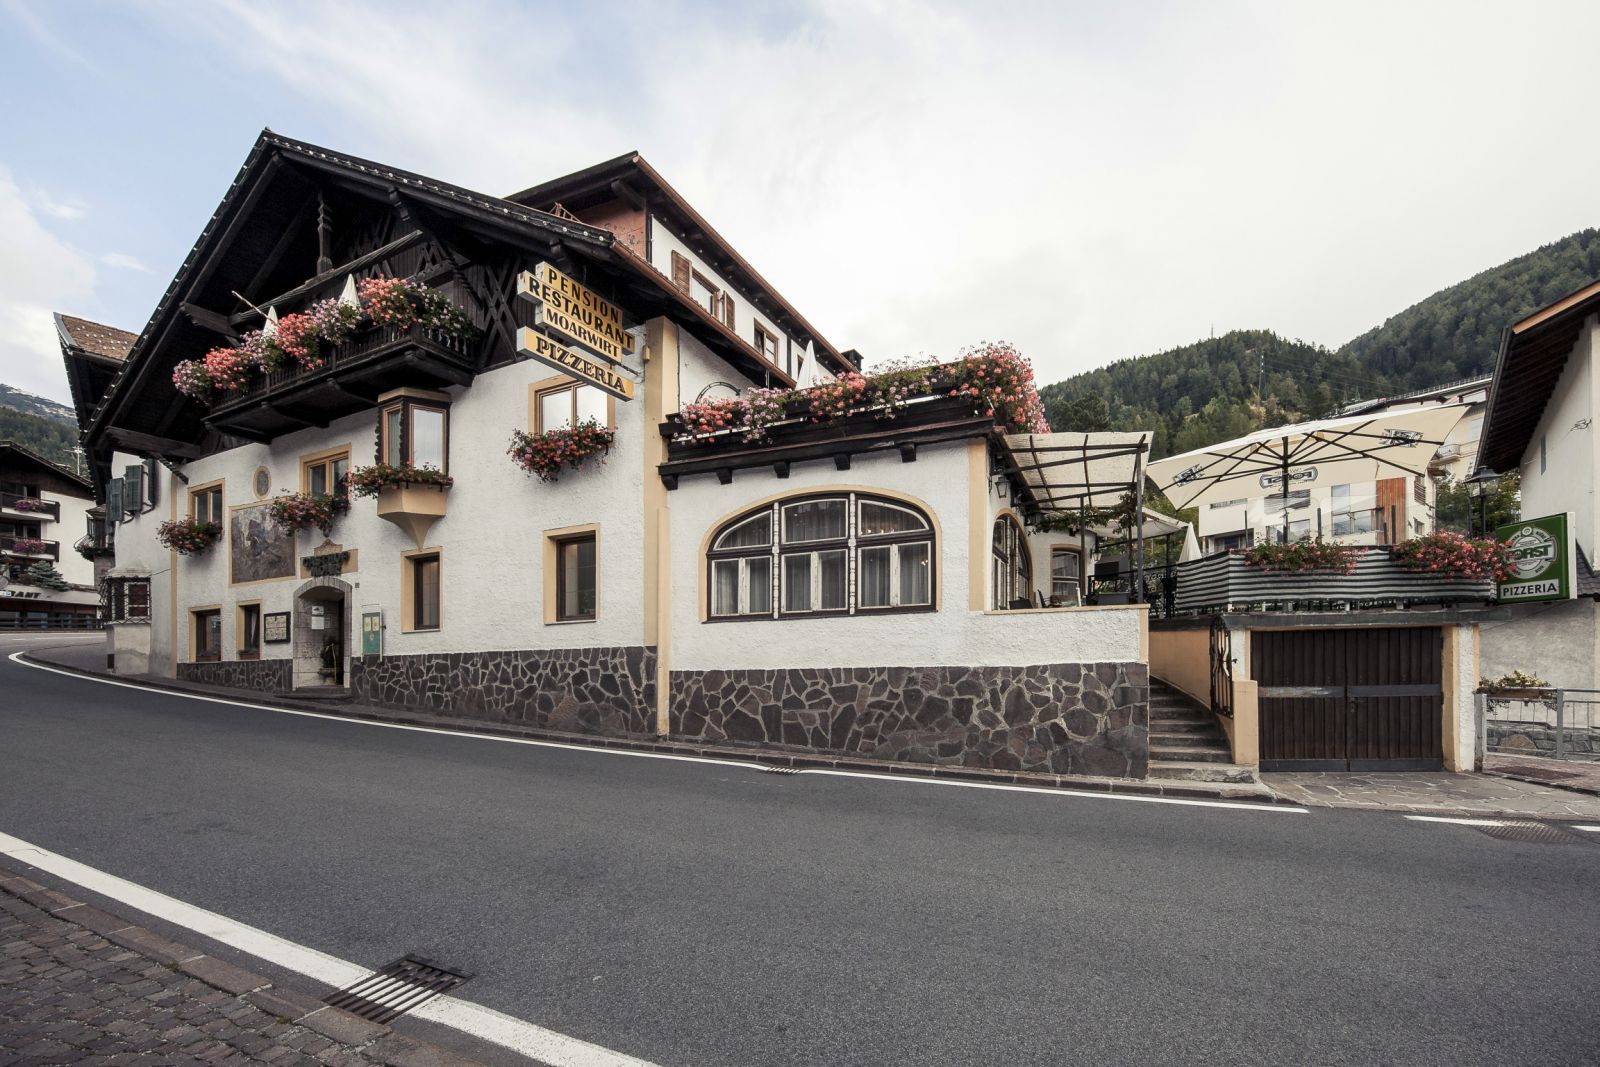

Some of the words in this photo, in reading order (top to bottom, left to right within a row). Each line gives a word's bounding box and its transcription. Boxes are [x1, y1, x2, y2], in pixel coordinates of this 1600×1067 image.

[529, 276, 633, 349] RESTAURANT
[548, 268, 619, 324] PENSION
[546, 308, 620, 358] MOARWIRT
[535, 335, 626, 394] PIZZERIA
[1510, 544, 1552, 560] ORST
[1503, 583, 1557, 597] PIZZERIA
